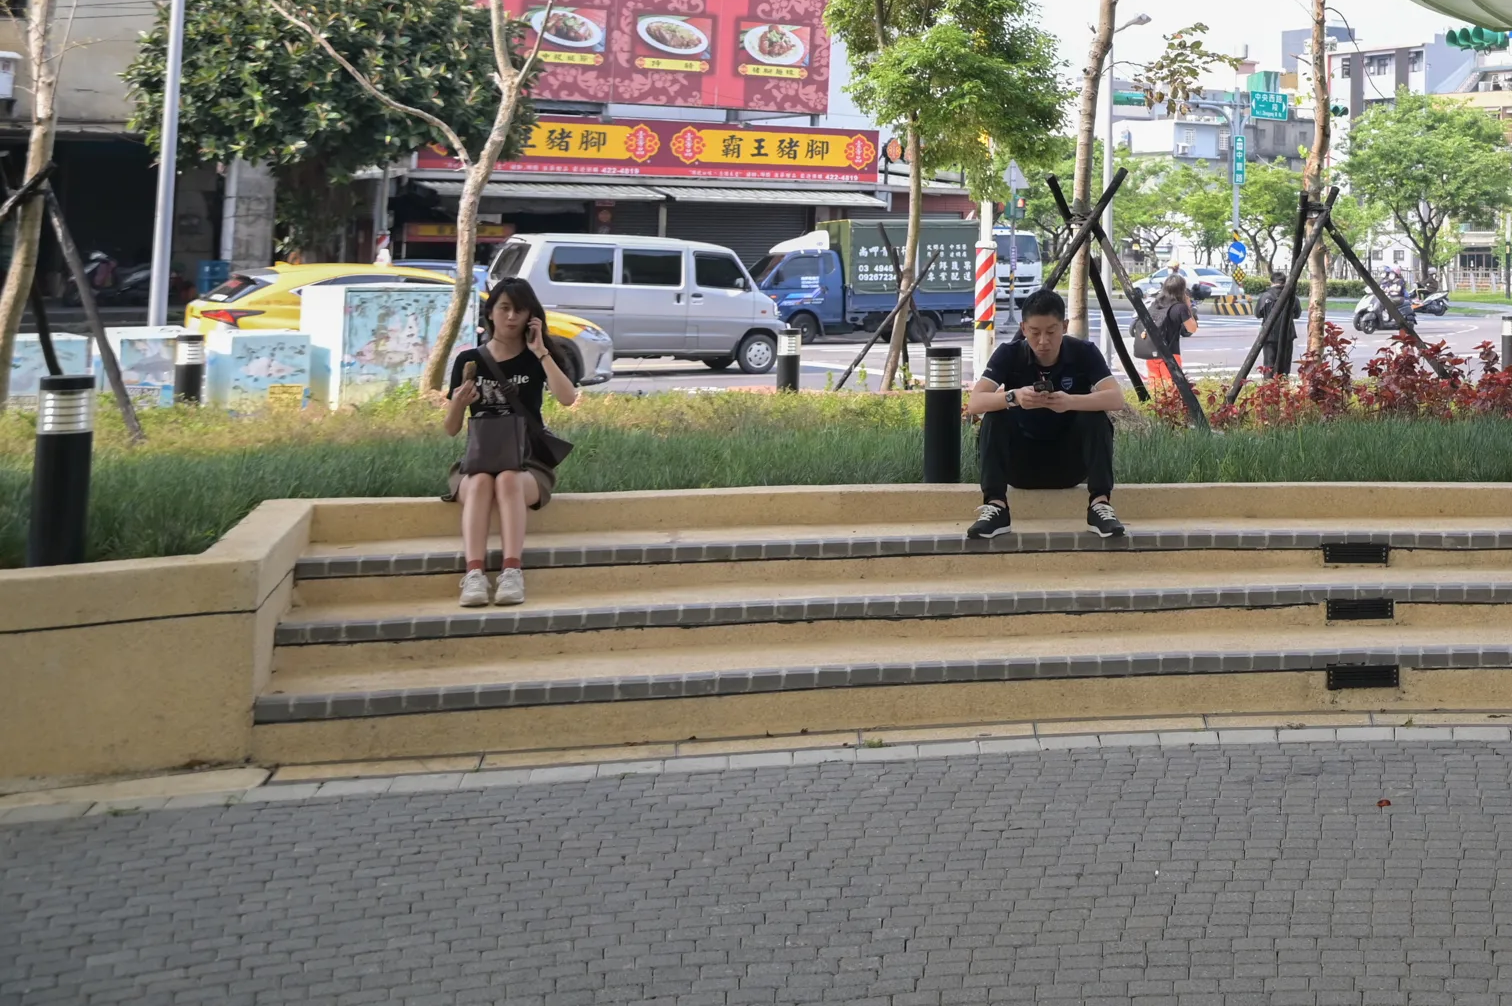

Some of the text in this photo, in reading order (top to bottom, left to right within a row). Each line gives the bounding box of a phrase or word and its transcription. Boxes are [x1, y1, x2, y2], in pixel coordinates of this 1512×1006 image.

[519, 125, 607, 153] 王豬腳
[721, 134, 830, 161] 霸王豬腳
[926, 272, 972, 282] 專業配送
